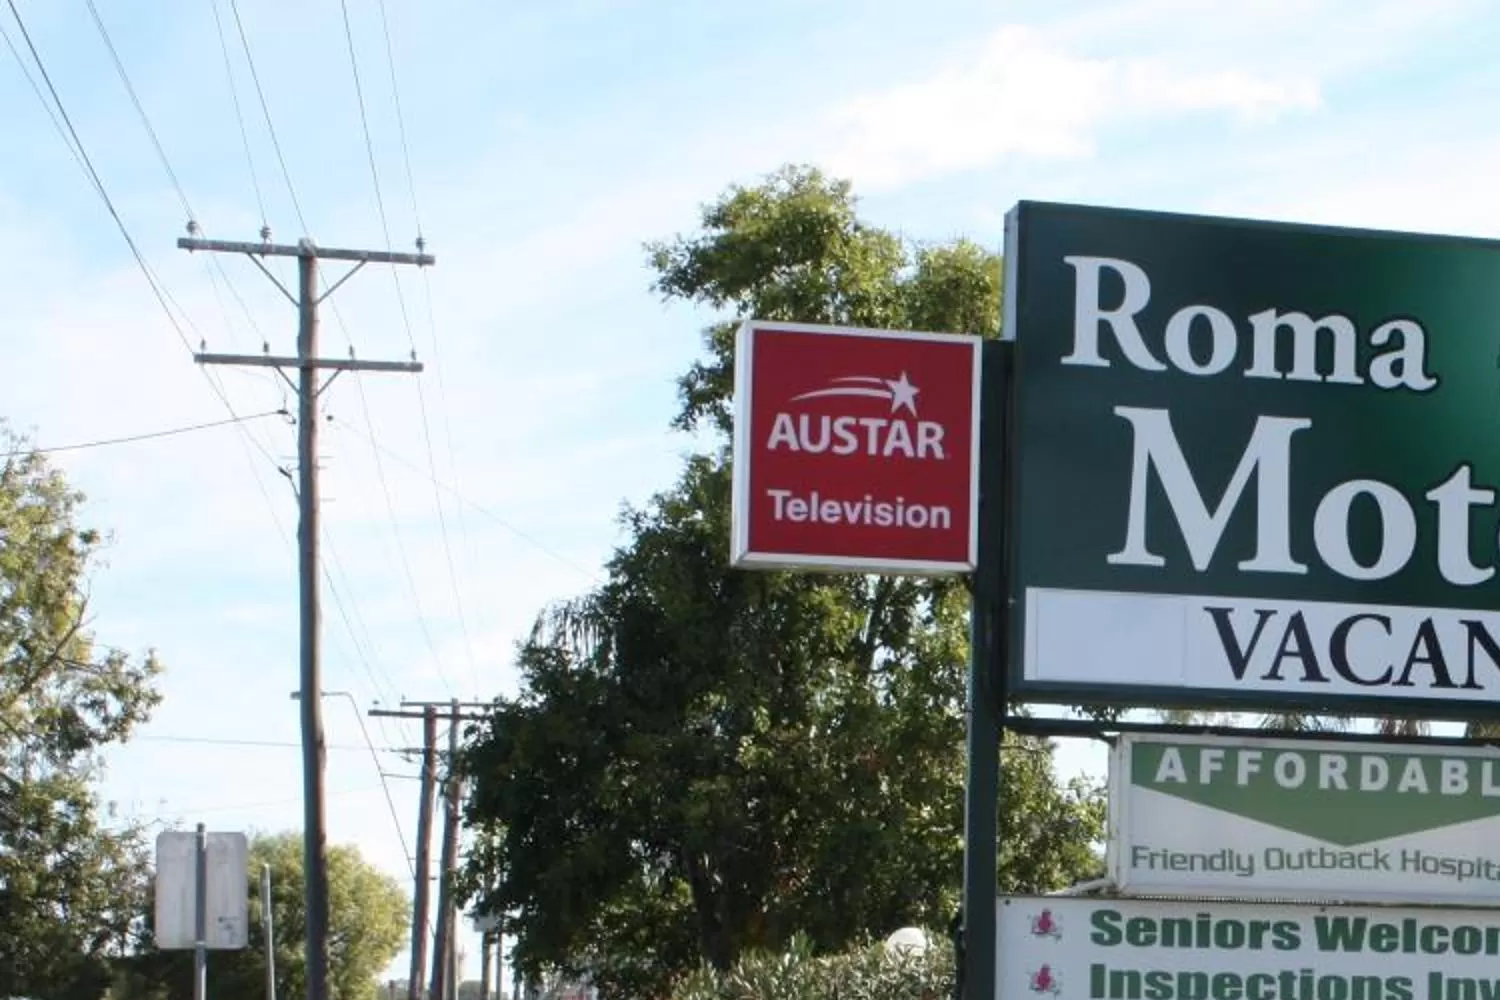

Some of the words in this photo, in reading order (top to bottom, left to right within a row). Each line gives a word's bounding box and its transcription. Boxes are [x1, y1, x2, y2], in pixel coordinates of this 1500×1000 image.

[1060, 255, 1437, 392] Roma
[767, 413, 946, 461] AUSTAR
[766, 489, 951, 529] Television
[1131, 845, 1254, 876] Friendly
[1265, 847, 1390, 873] Outback
[1090, 909, 1300, 950] Seniors
